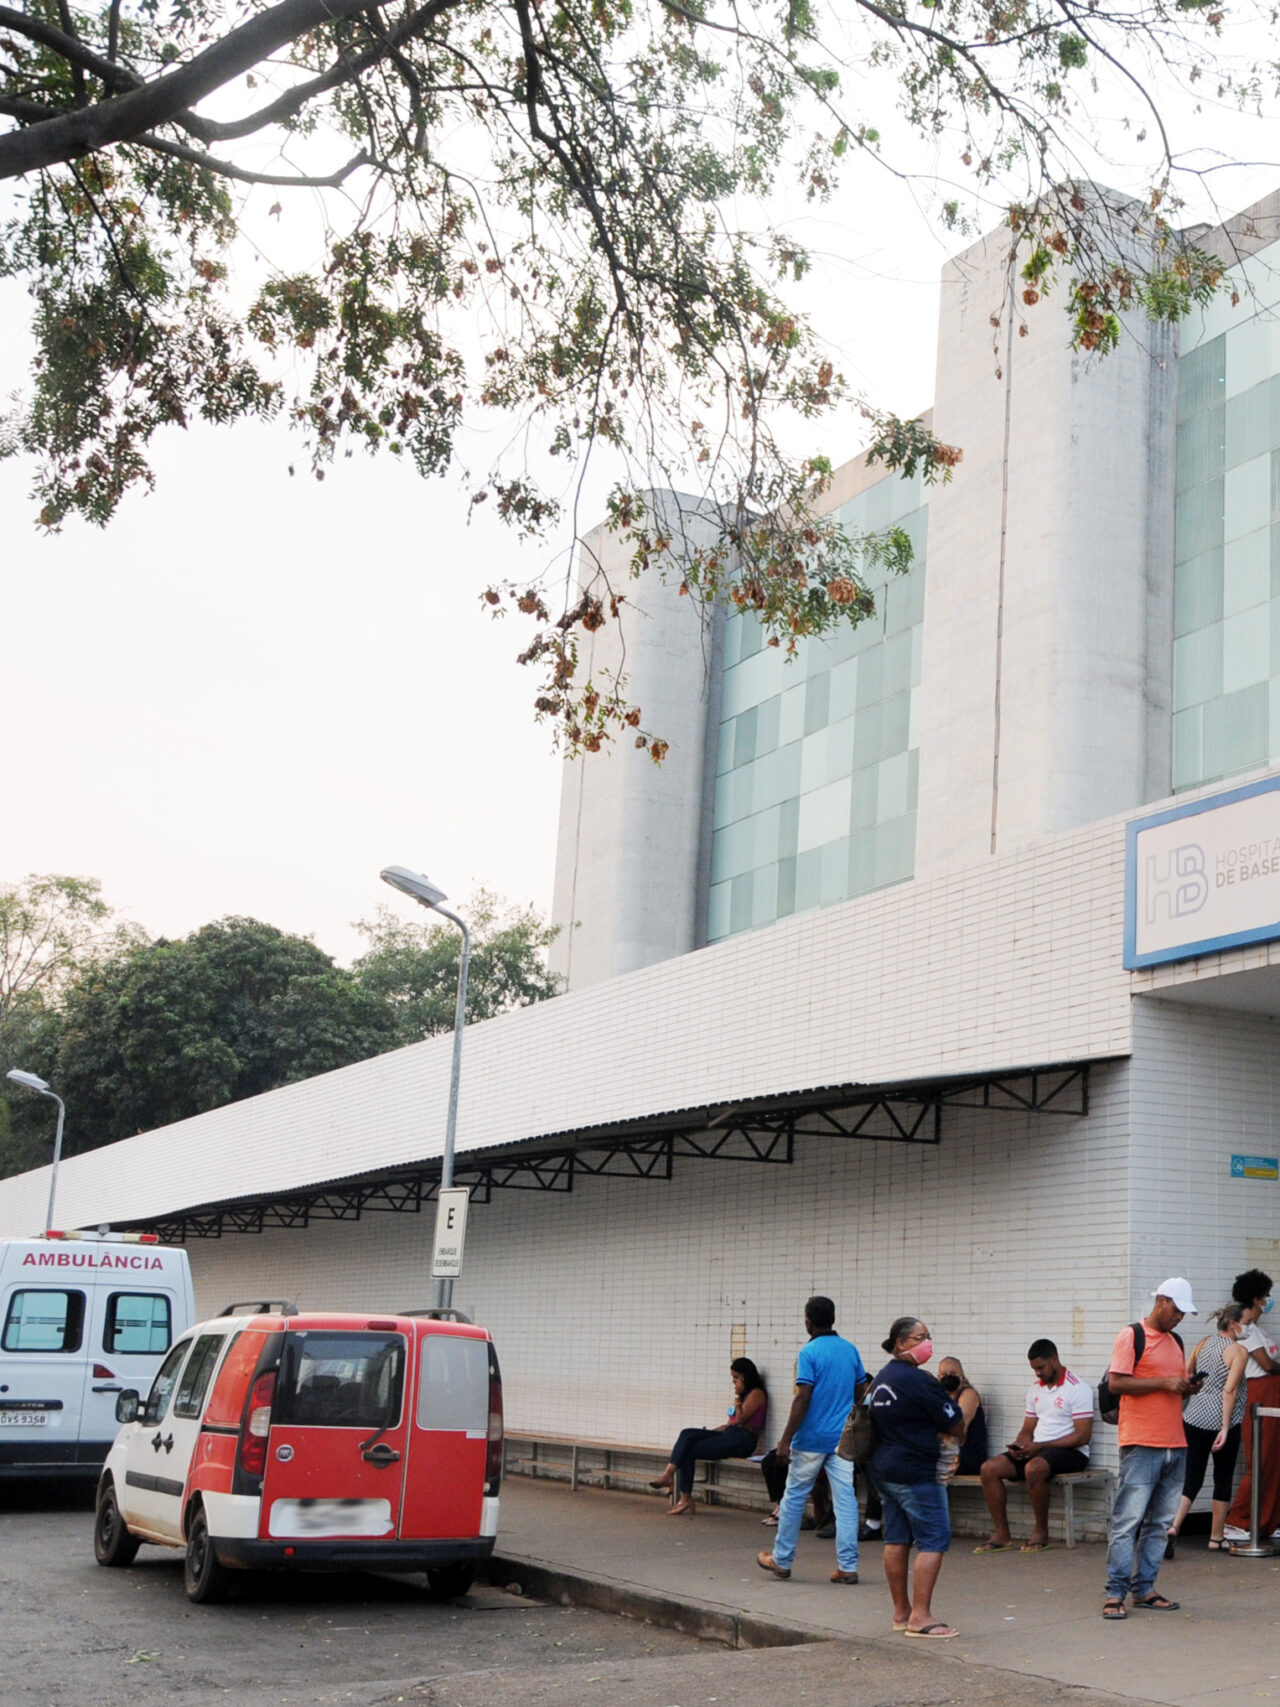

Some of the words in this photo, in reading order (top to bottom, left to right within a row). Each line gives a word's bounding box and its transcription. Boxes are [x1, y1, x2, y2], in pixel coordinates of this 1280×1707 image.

[1216, 868, 1236, 888] DE
[1240, 856, 1280, 882] BASE
[447, 1207, 455, 1229] E
[21, 1251, 164, 1271] AMBULÂNCIA
